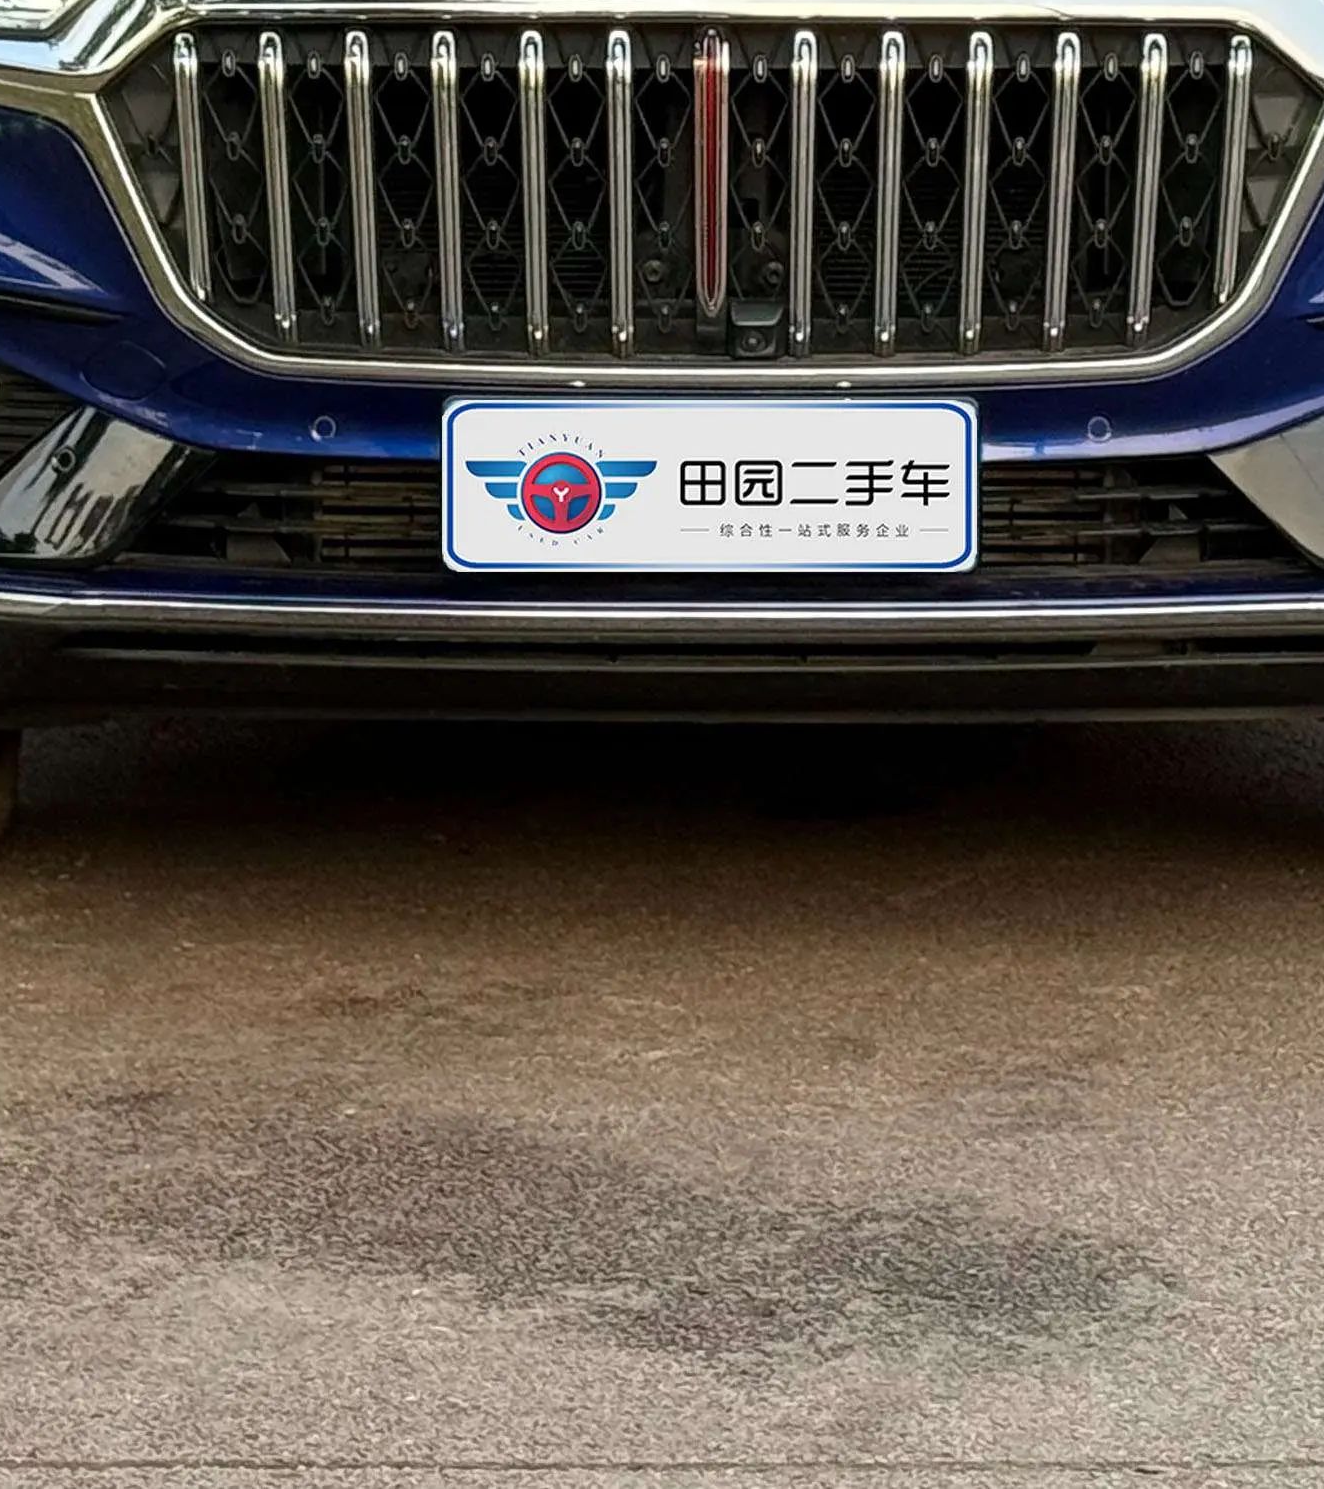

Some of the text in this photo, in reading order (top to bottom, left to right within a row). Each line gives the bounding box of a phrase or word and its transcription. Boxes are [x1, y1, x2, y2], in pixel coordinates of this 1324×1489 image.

[679, 459, 951, 506] 田园二手车
[719, 523, 910, 539] 综合性一站式服务企业
